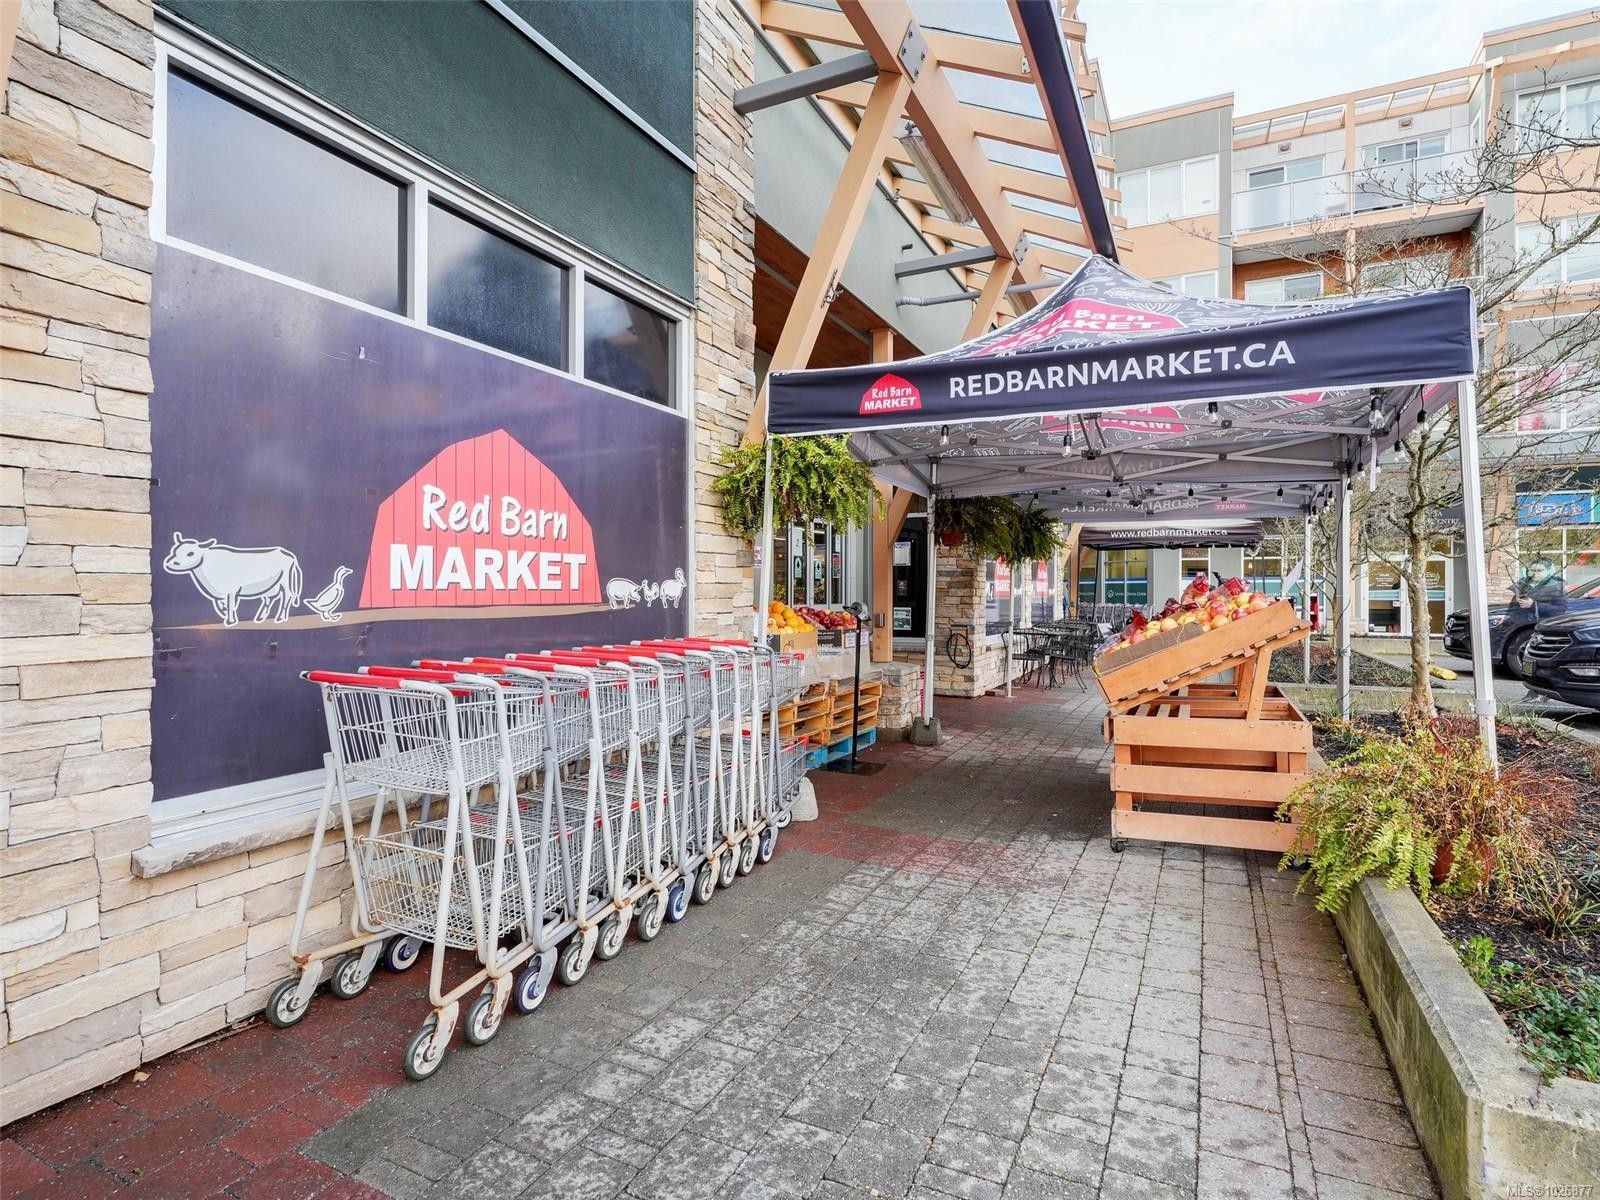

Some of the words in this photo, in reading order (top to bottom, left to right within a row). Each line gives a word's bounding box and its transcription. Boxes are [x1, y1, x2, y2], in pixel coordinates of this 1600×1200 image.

[1074, 309, 1146, 321] Barn
[989, 320, 1162, 352] MARKET
[950, 341, 1296, 398] REDBARNMARKET.CA
[864, 397, 916, 410] MARKET
[871, 388, 888, 399] Red
[890, 386, 912, 397] Barn
[422, 483, 491, 534] Red
[500, 495, 568, 540] Barn
[1110, 528, 1228, 538] www.redbarnmarket.ca
[389, 543, 587, 591] MARKET
